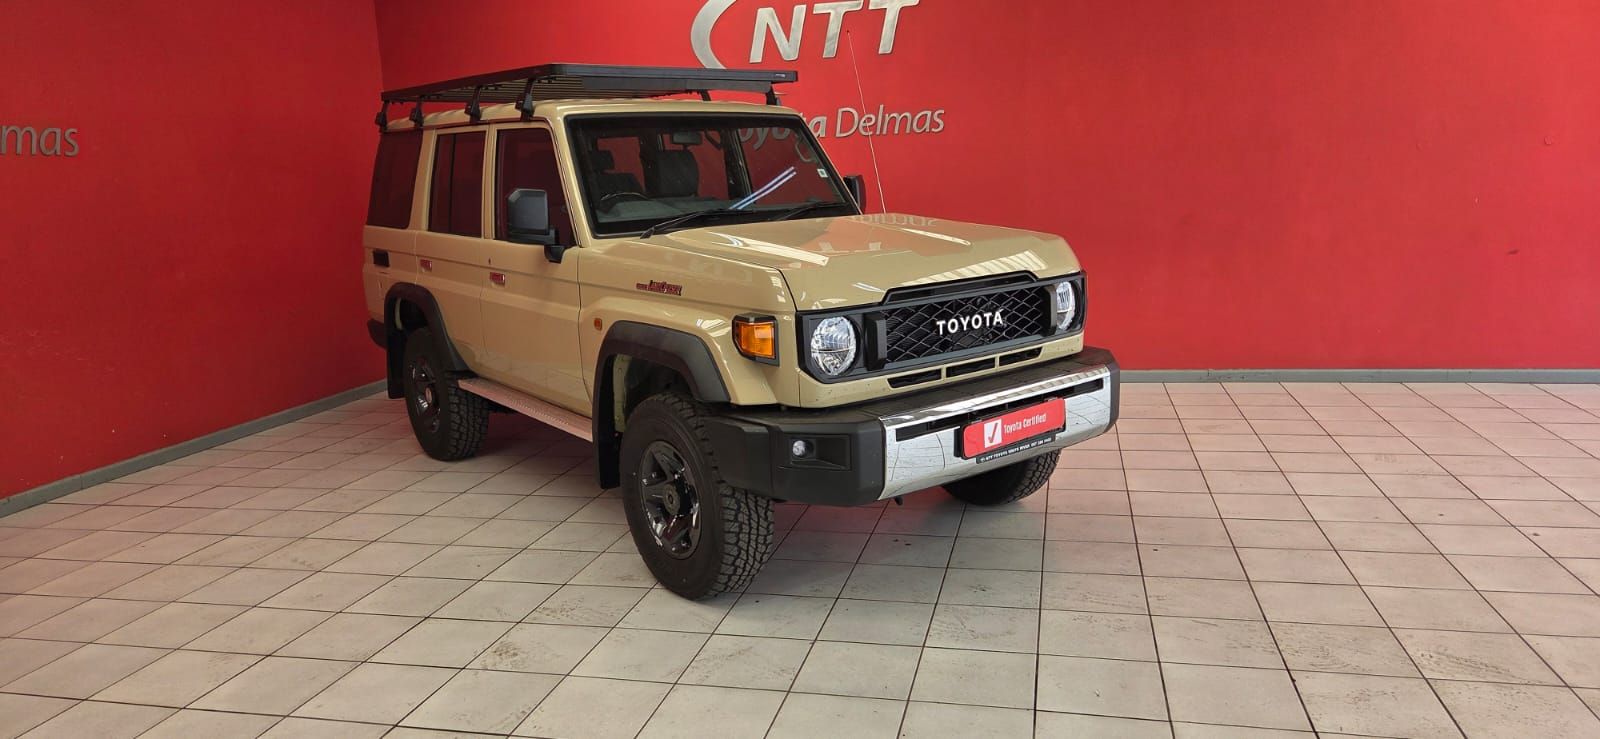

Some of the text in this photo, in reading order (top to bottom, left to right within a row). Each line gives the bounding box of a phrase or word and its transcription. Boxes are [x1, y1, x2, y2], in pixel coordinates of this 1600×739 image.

[749, 0, 920, 64] NTT
[835, 104, 945, 138] Delmas
[0, 125, 80, 156] mas
[936, 310, 1003, 335] TOYOTA
[1004, 413, 1046, 433] Toyota Certified
